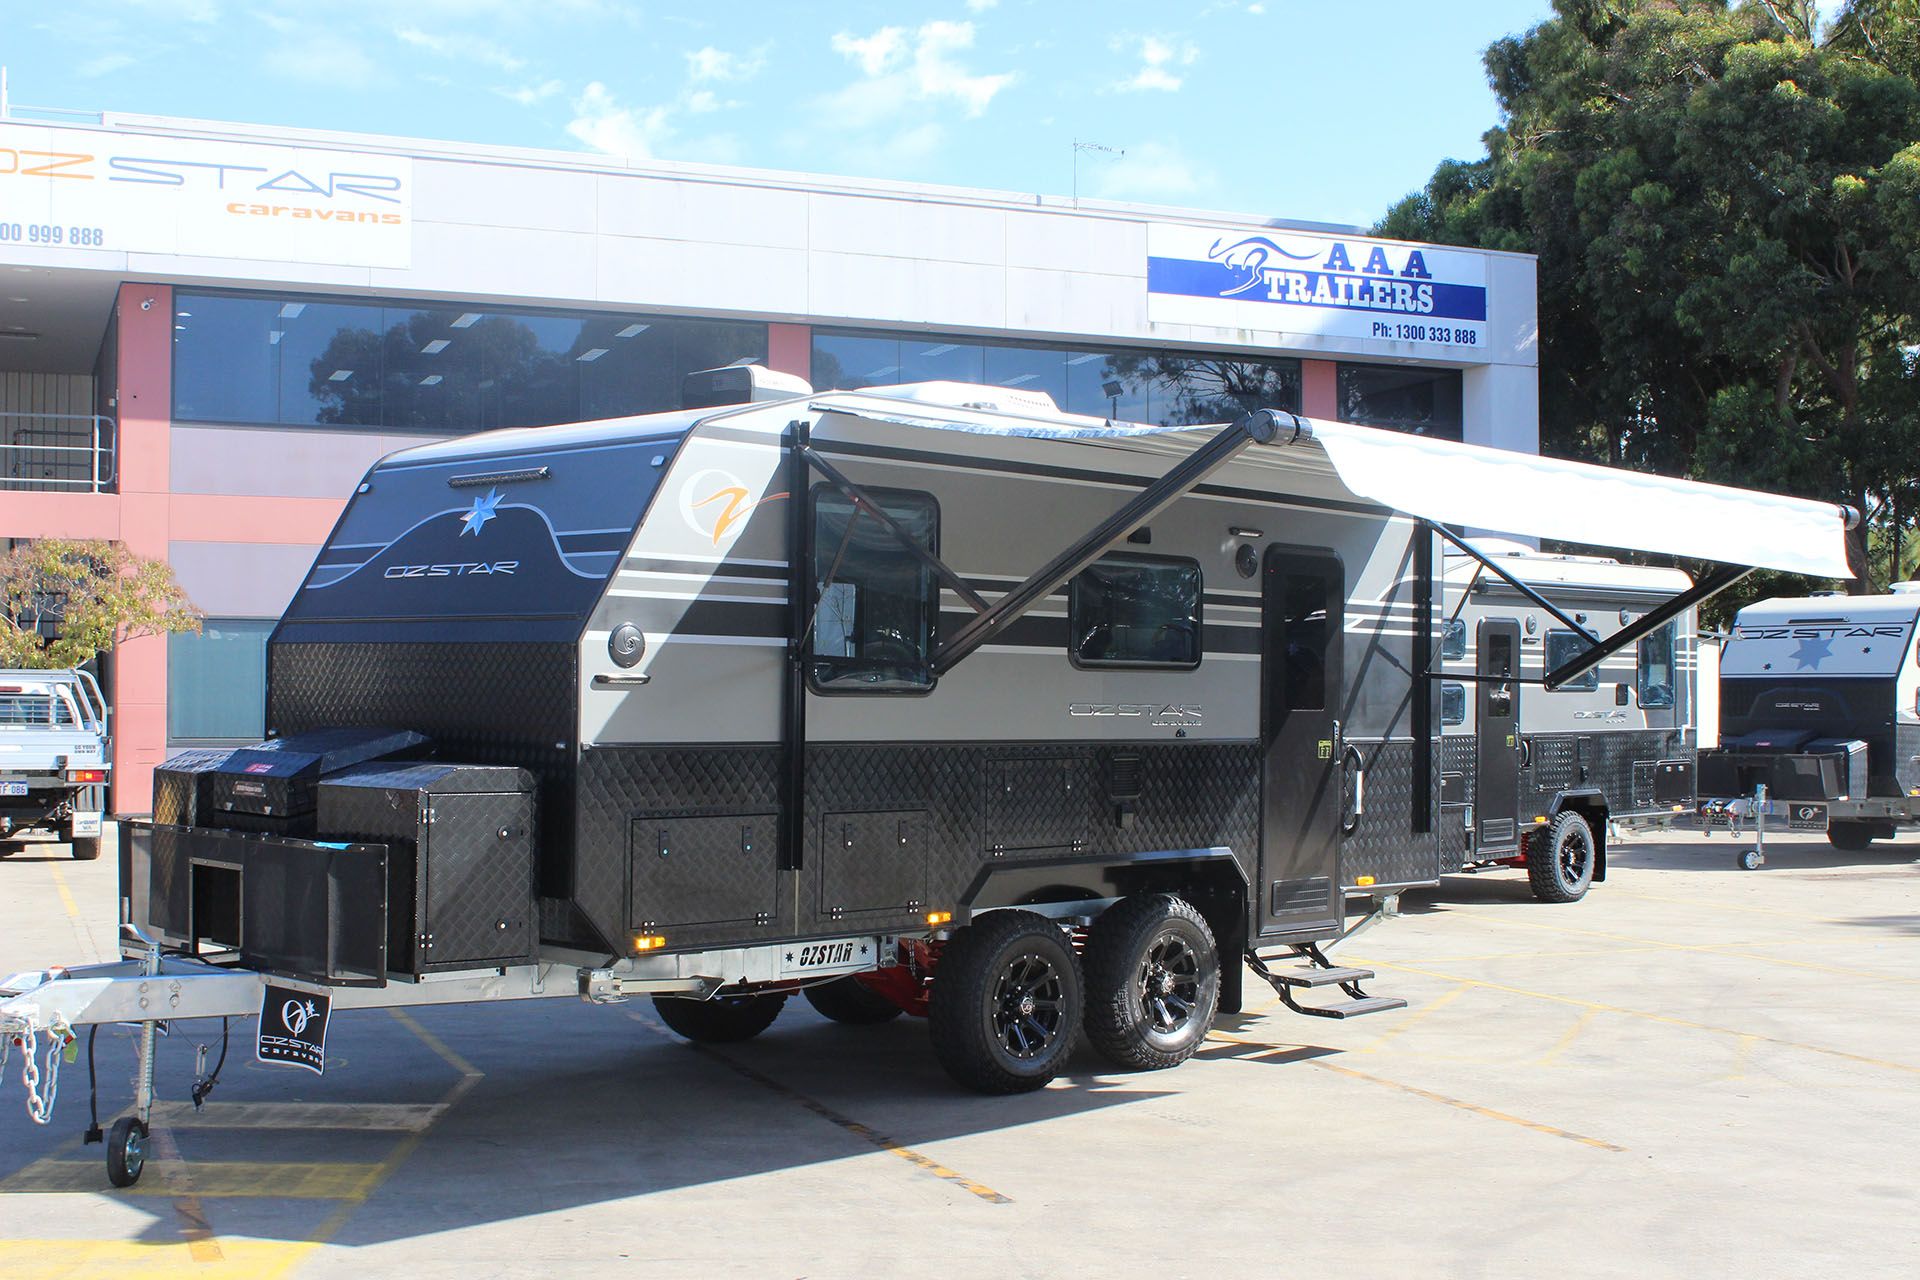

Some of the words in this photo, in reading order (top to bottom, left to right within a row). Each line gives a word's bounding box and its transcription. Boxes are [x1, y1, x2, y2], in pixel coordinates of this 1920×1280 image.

[0, 148, 401, 204] ZSTAR
[226, 202, 402, 225] caravans
[28, 224, 63, 244] 999
[69, 226, 104, 247] 888
[1263, 270, 1434, 314] TRAILERS
[1372, 322, 1392, 338] Ph:
[1396, 324, 1425, 341] 1300
[1429, 327, 1451, 343] 333
[1454, 329, 1476, 345] 888
[384, 560, 519, 579] OZSTAR
[1739, 626, 1904, 640] OZSTAR
[1069, 703, 1202, 717] OZSTAR
[799, 943, 853, 967] OZSTAR
[260, 1035, 324, 1057] OZSTAR
